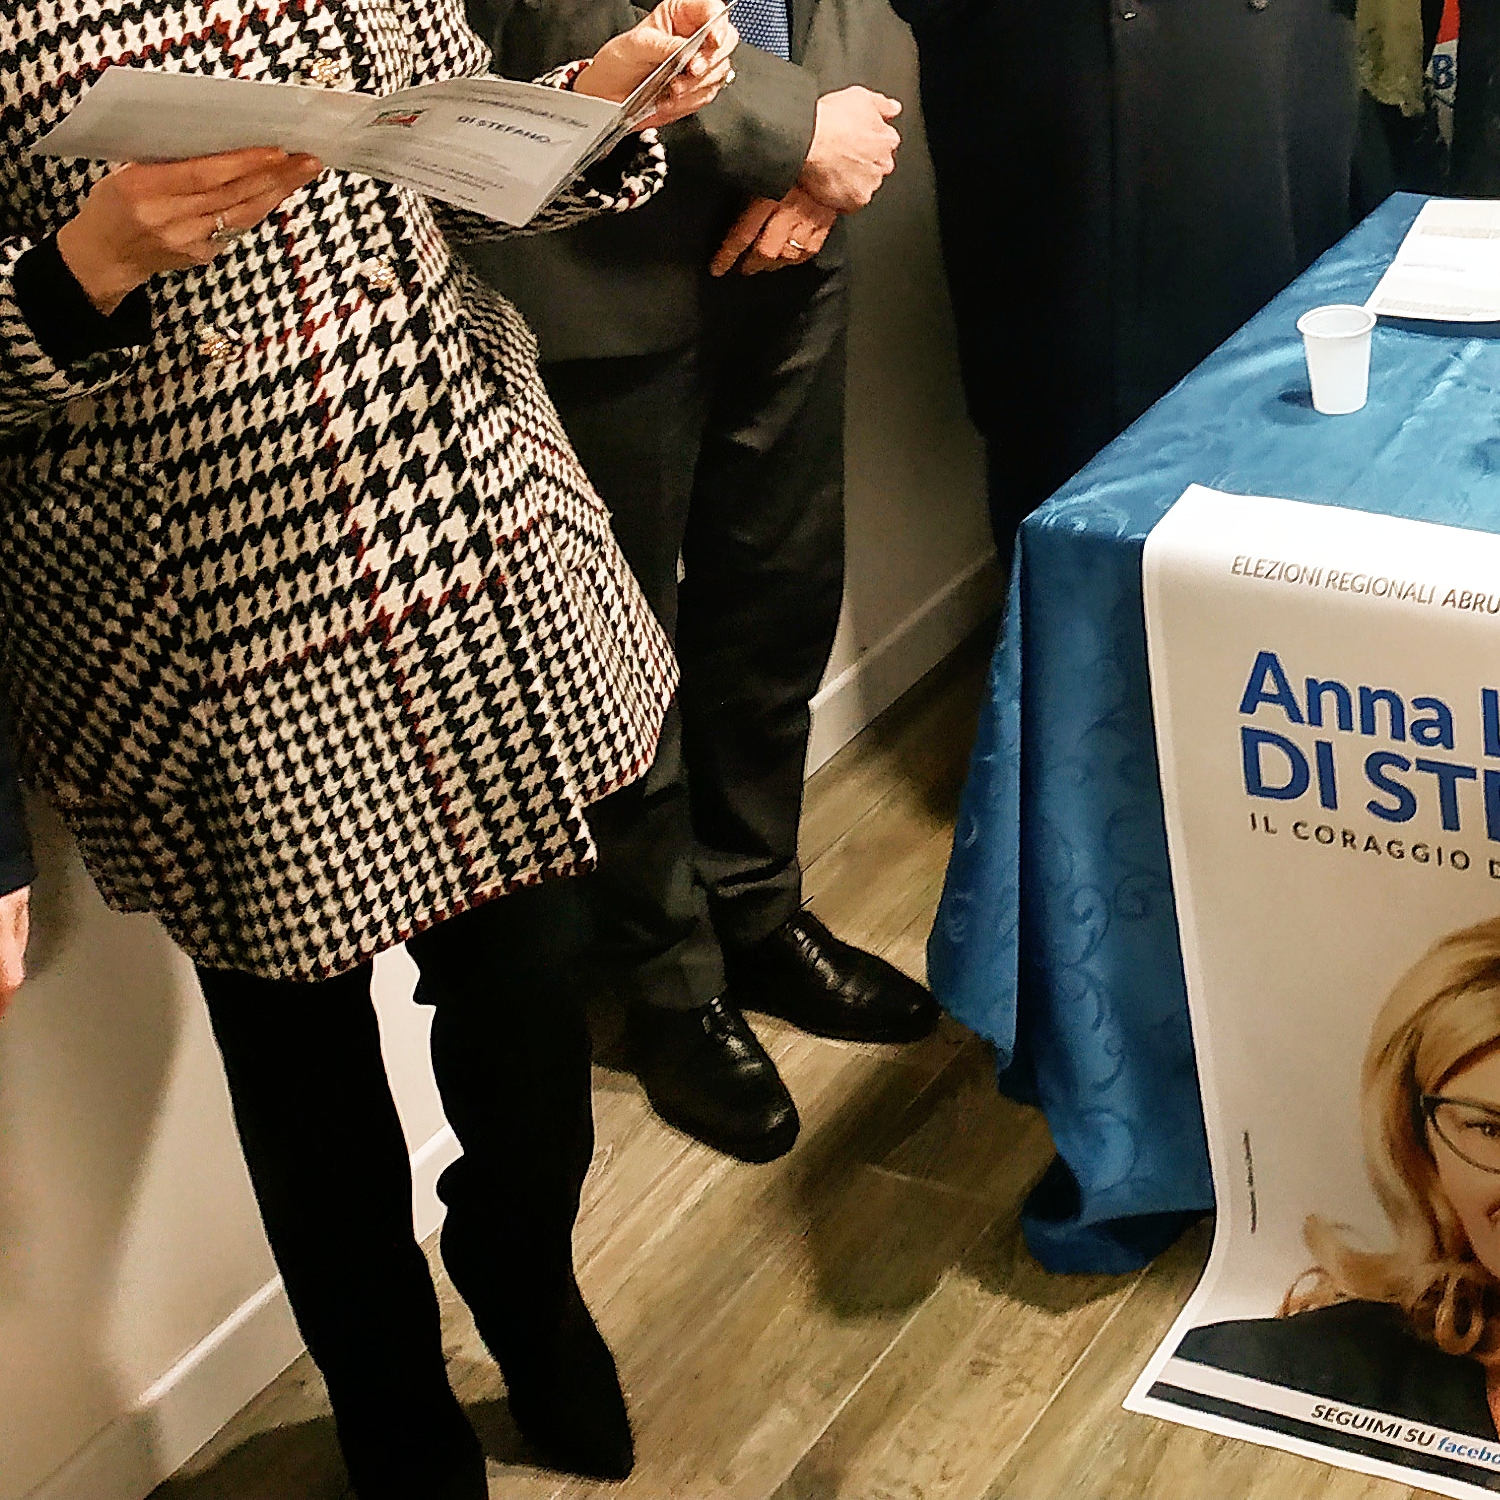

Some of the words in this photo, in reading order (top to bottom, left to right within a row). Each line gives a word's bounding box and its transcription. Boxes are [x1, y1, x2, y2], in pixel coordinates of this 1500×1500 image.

[1230, 554, 1324, 587] ELEZIONI
[1324, 568, 1437, 605] REGIONALI
[1238, 650, 1456, 751] Anna
[1240, 726, 1339, 811] DI
[1249, 811, 1278, 835] IL
[1292, 820, 1471, 872] CORAGGIO
[1310, 1403, 1404, 1440] SEGUIMI
[1403, 1428, 1437, 1448] SU
